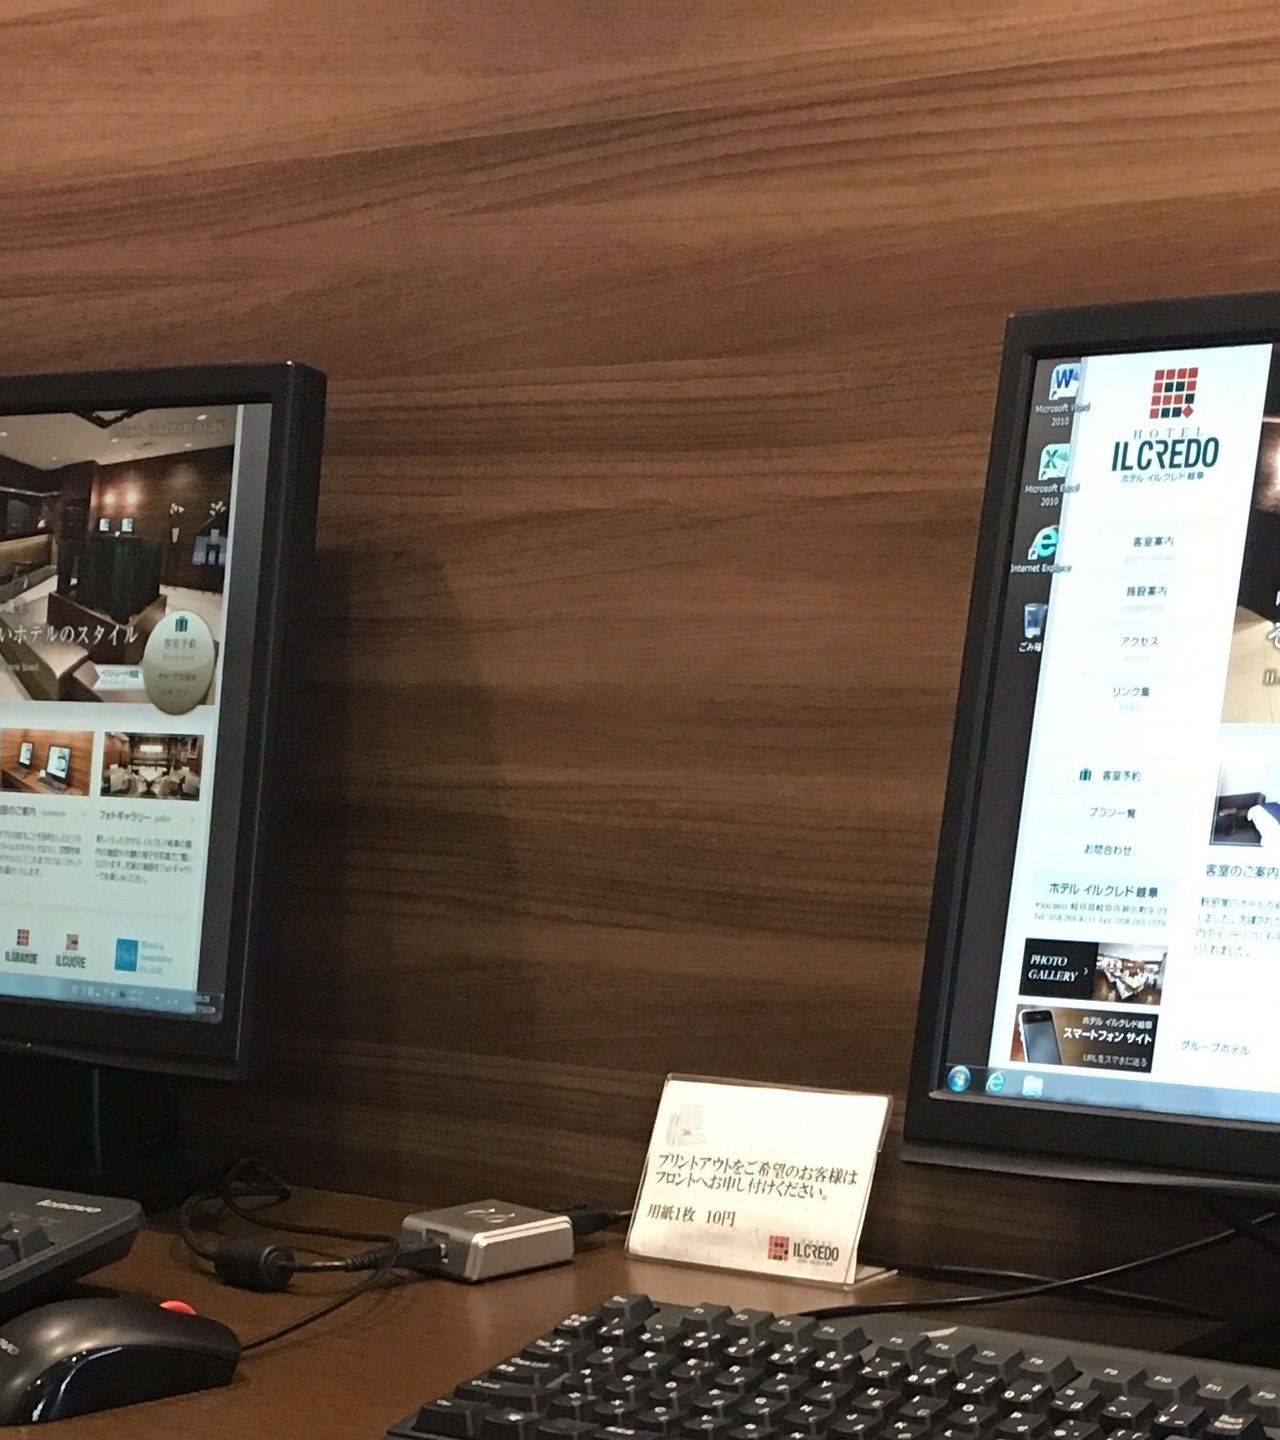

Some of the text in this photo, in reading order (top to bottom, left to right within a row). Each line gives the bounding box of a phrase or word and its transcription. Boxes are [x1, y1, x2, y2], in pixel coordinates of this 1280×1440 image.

[1133, 426, 1204, 439] HOTEL
[1111, 437, 1220, 471] ILCREDO
[1120, 636, 1158, 647] アクセス
[1113, 686, 1150, 698] リンク集
[1206, 863, 1280, 879] 客室のご案内
[1049, 882, 1079, 896] ホテル
[1030, 954, 1068, 967] PHOTO
[1028, 968, 1079, 982] GALLERY
[1063, 1028, 1153, 1045] スマートフォン サイト
[1182, 1040, 1250, 1056] グループホテル
[658, 1153, 859, 1186] プリントアウトをご希望のお客様は
[655, 1170, 828, 1202] フロントへお申し付けください。
[646, 1203, 737, 1228] 用紙1枚 10円
[792, 1242, 840, 1262] ILCREDO
